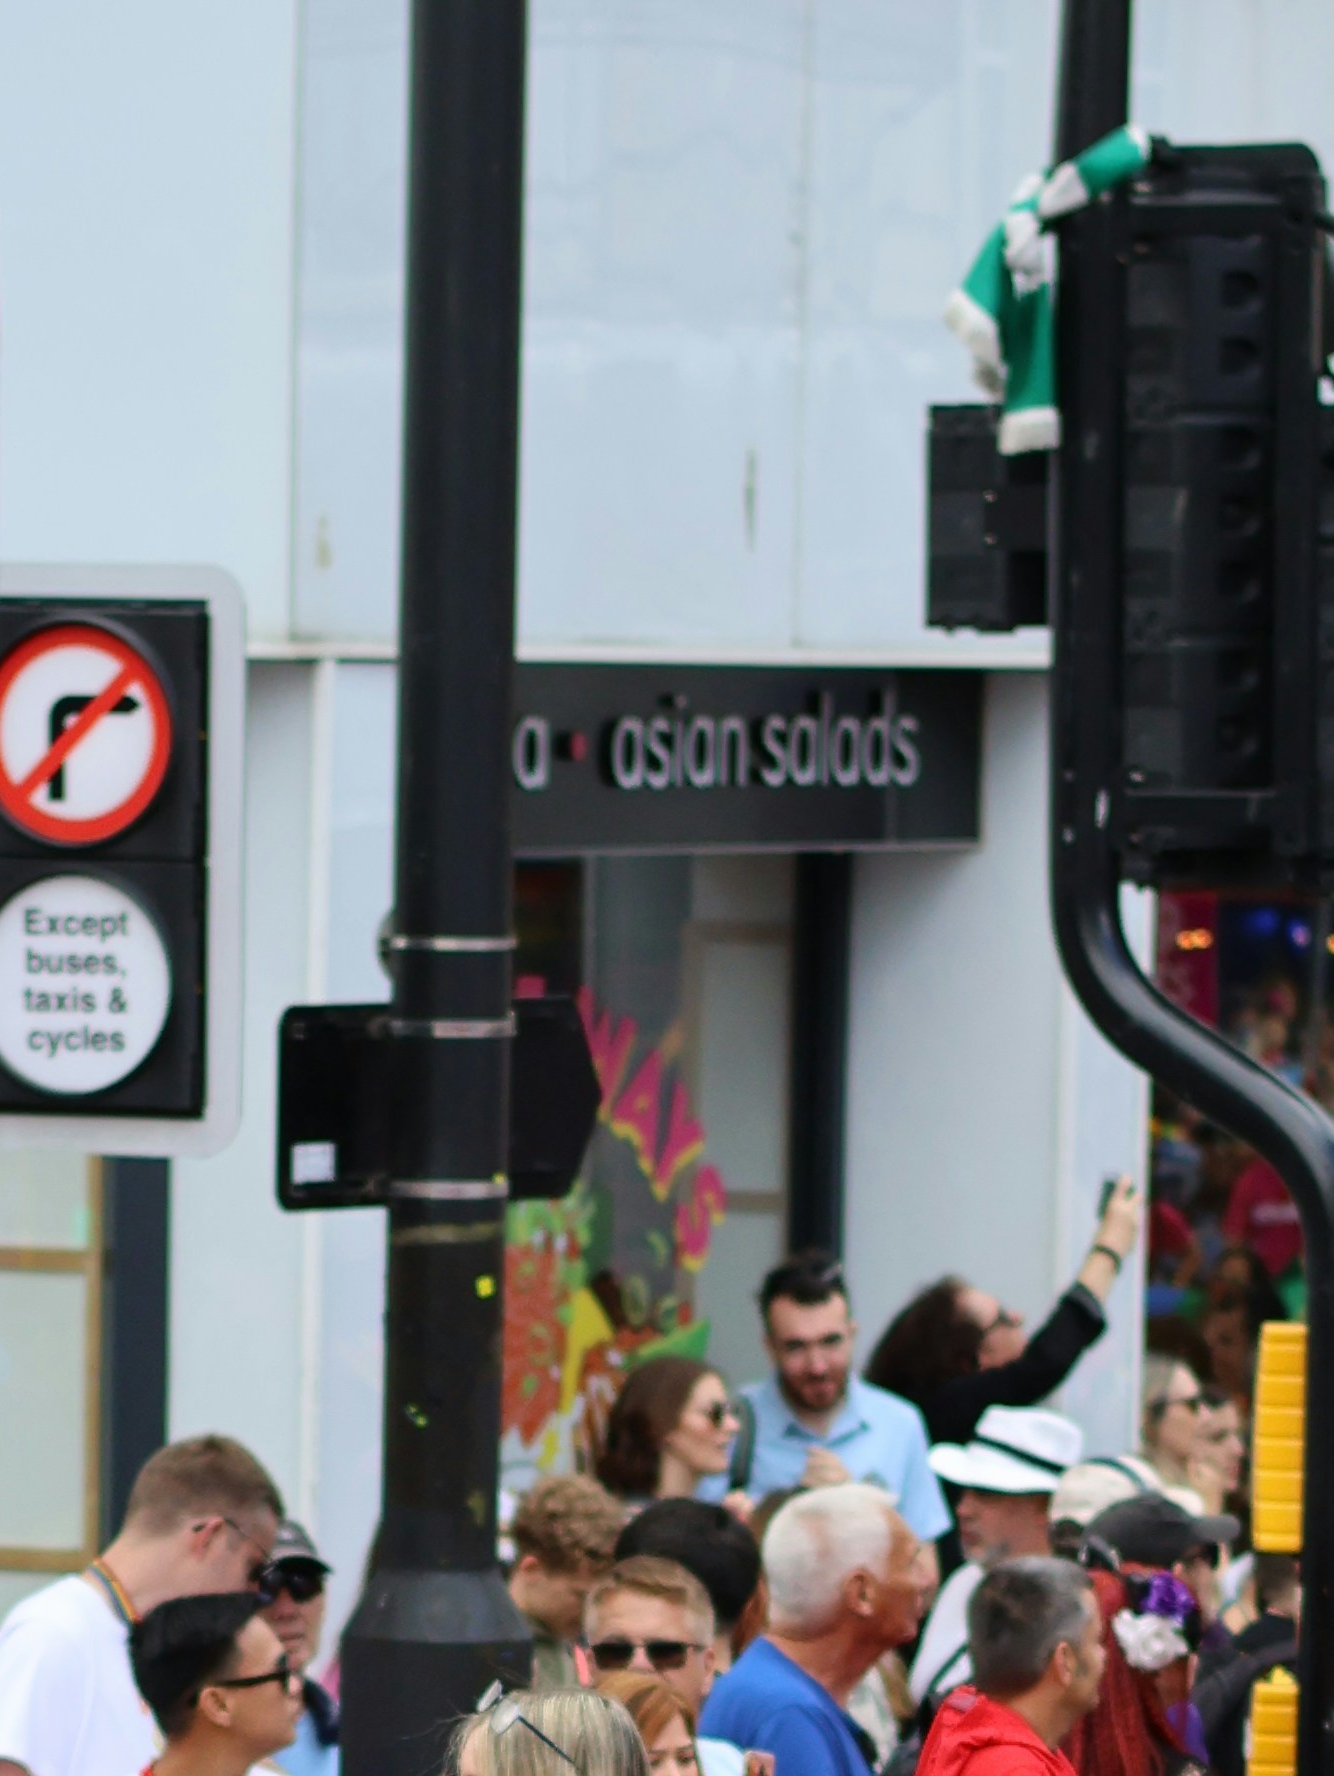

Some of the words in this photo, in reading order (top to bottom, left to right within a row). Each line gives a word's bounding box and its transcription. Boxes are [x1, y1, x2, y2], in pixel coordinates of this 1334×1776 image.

[612, 694, 748, 790] asian
[761, 690, 921, 788] salads
[24, 908, 129, 943] Except
[26, 948, 127, 978] buses,
[24, 986, 96, 1012] taxis
[108, 986, 128, 1013] &
[27, 1025, 126, 1058] cycles
